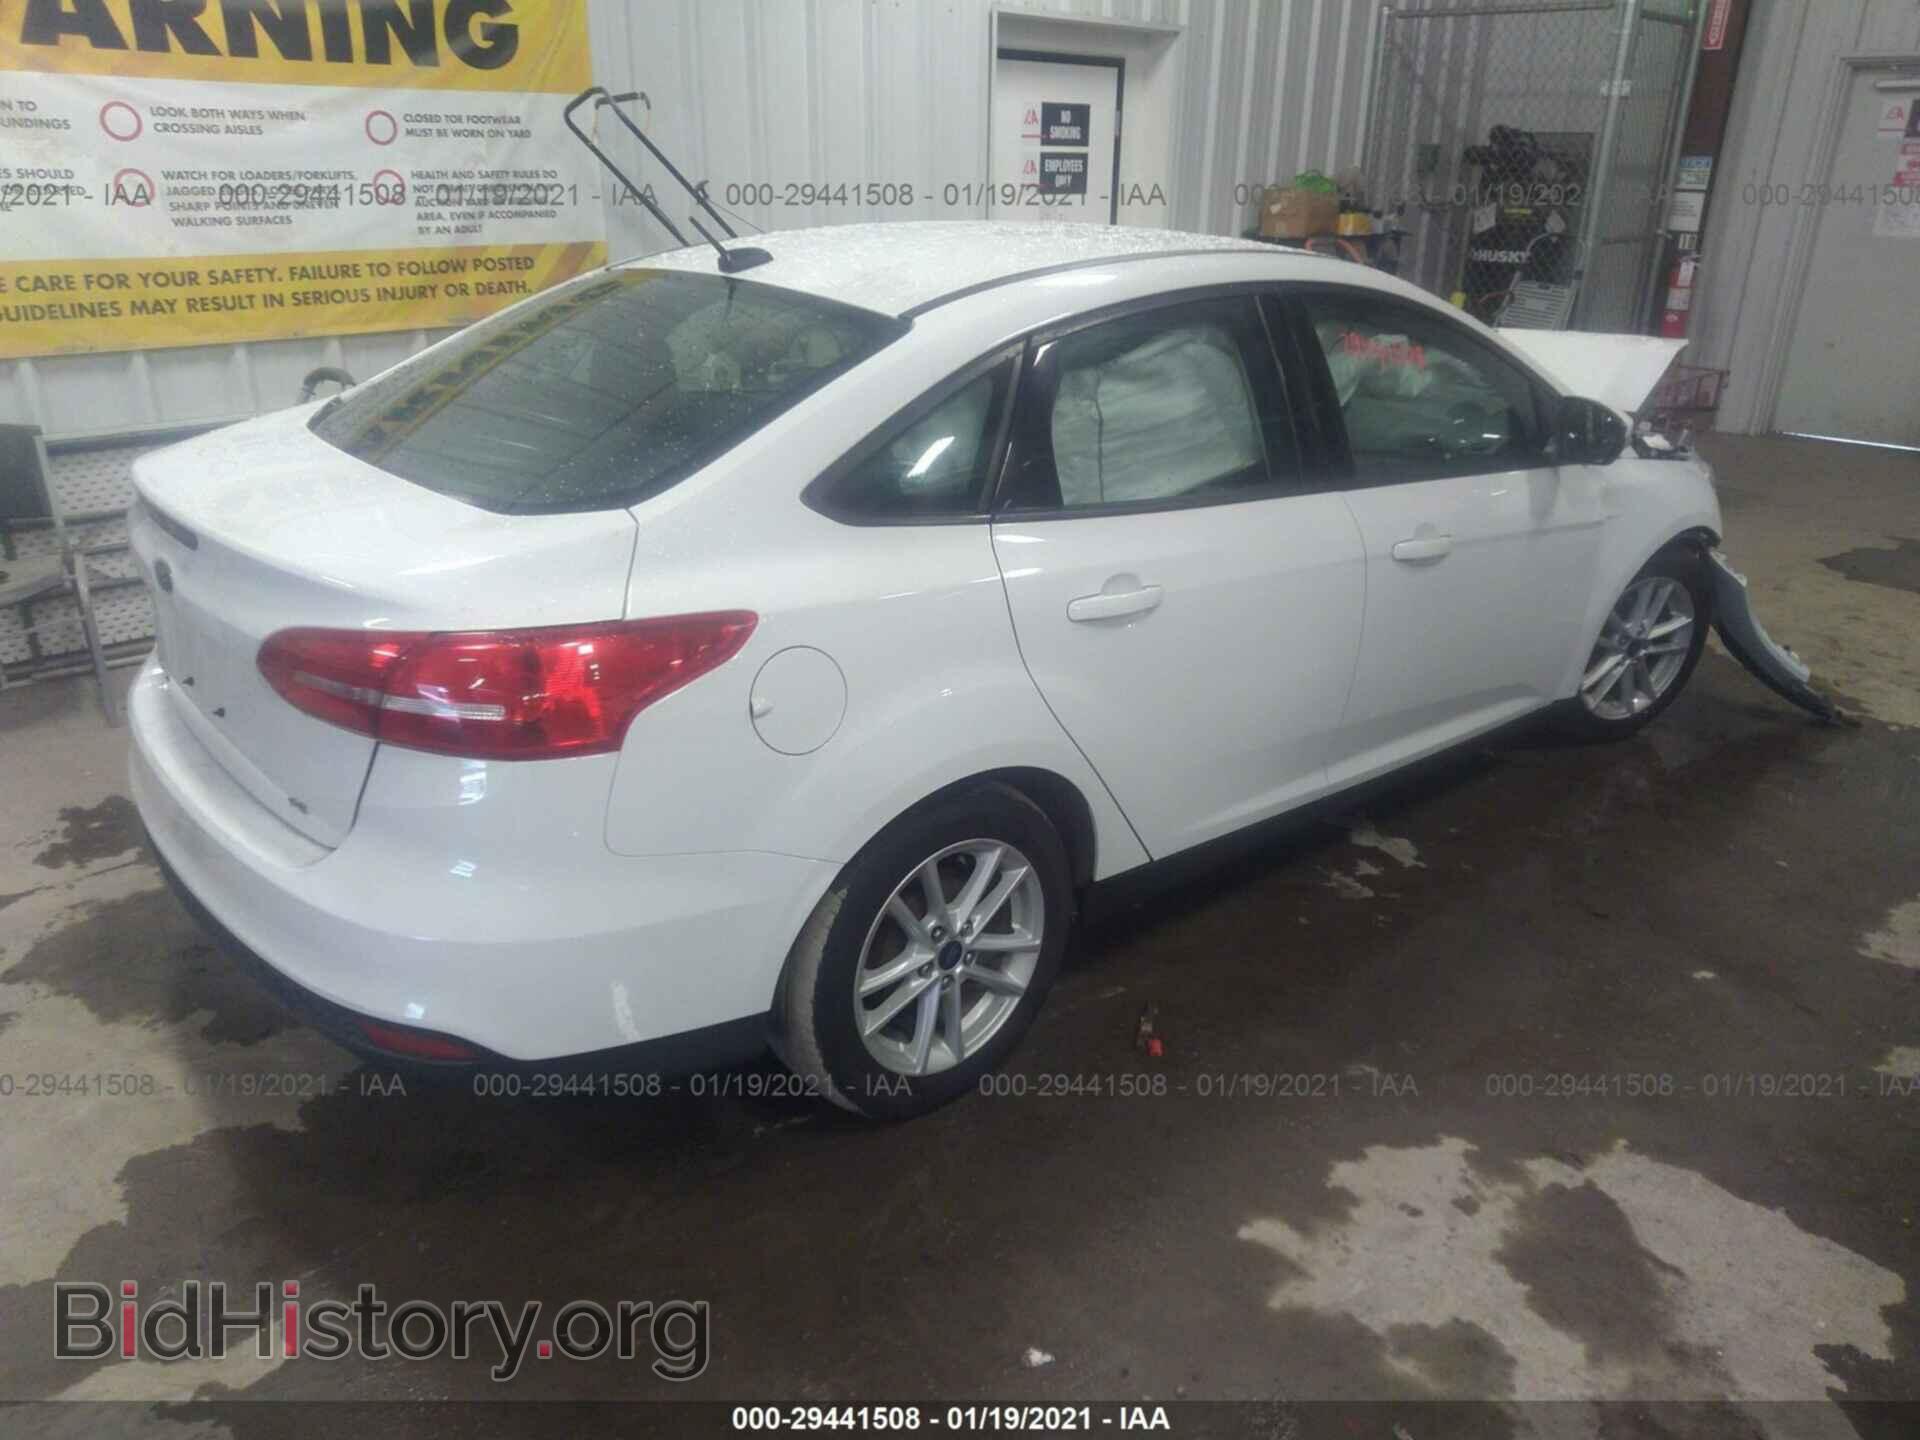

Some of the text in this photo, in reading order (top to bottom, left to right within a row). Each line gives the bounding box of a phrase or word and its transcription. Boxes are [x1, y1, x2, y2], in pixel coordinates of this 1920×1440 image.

[16, 101, 37, 111] TO
[150, 106, 305, 121] LOOK BOTH WAYS WHEN
[403, 113, 520, 124] CLOSED TOE FOOTWEAR
[1060, 110, 1071, 123] NO
[153, 122, 263, 135] CROSSING AISLES
[405, 127, 531, 138] MUST BE WORN ON YARD
[1045, 159, 1083, 171] EMPLOYEES
[16, 168, 74, 179] SHOULD
[161, 171, 207, 180] WATCH
[211, 171, 236, 180] FOR
[411, 170, 558, 179] HEALTH AND SAFETY RULES DO
[166, 186, 216, 196] JAGGED
[413, 184, 434, 193] NOT
[169, 202, 210, 212] SHARP
[450, 211, 475, 220] EVEN
[488, 210, 557, 219] ACCOMPANIED
[171, 215, 293, 227] WALKING SURFACES
[418, 225, 482, 235] BY AN ADULT
[1478, 249, 1529, 263] HUSKY
[16, 274, 76, 292] CARE
[84, 273, 130, 290] FOR
[138, 271, 200, 289] YOUR
[207, 267, 282, 286] SAFETY.
[290, 262, 360, 281] FAILURE
[366, 262, 391, 277] TO
[399, 258, 466, 276] FOLLOW
[473, 256, 534, 272] POSTED
[130, 299, 177, 316] MAY
[187, 294, 255, 313] RESULT
[263, 292, 284, 308] IN
[292, 287, 370, 306] SERIOUS
[377, 283, 438, 301] INJURY
[445, 282, 469, 297] OR
[476, 279, 531, 296] DEATH.
